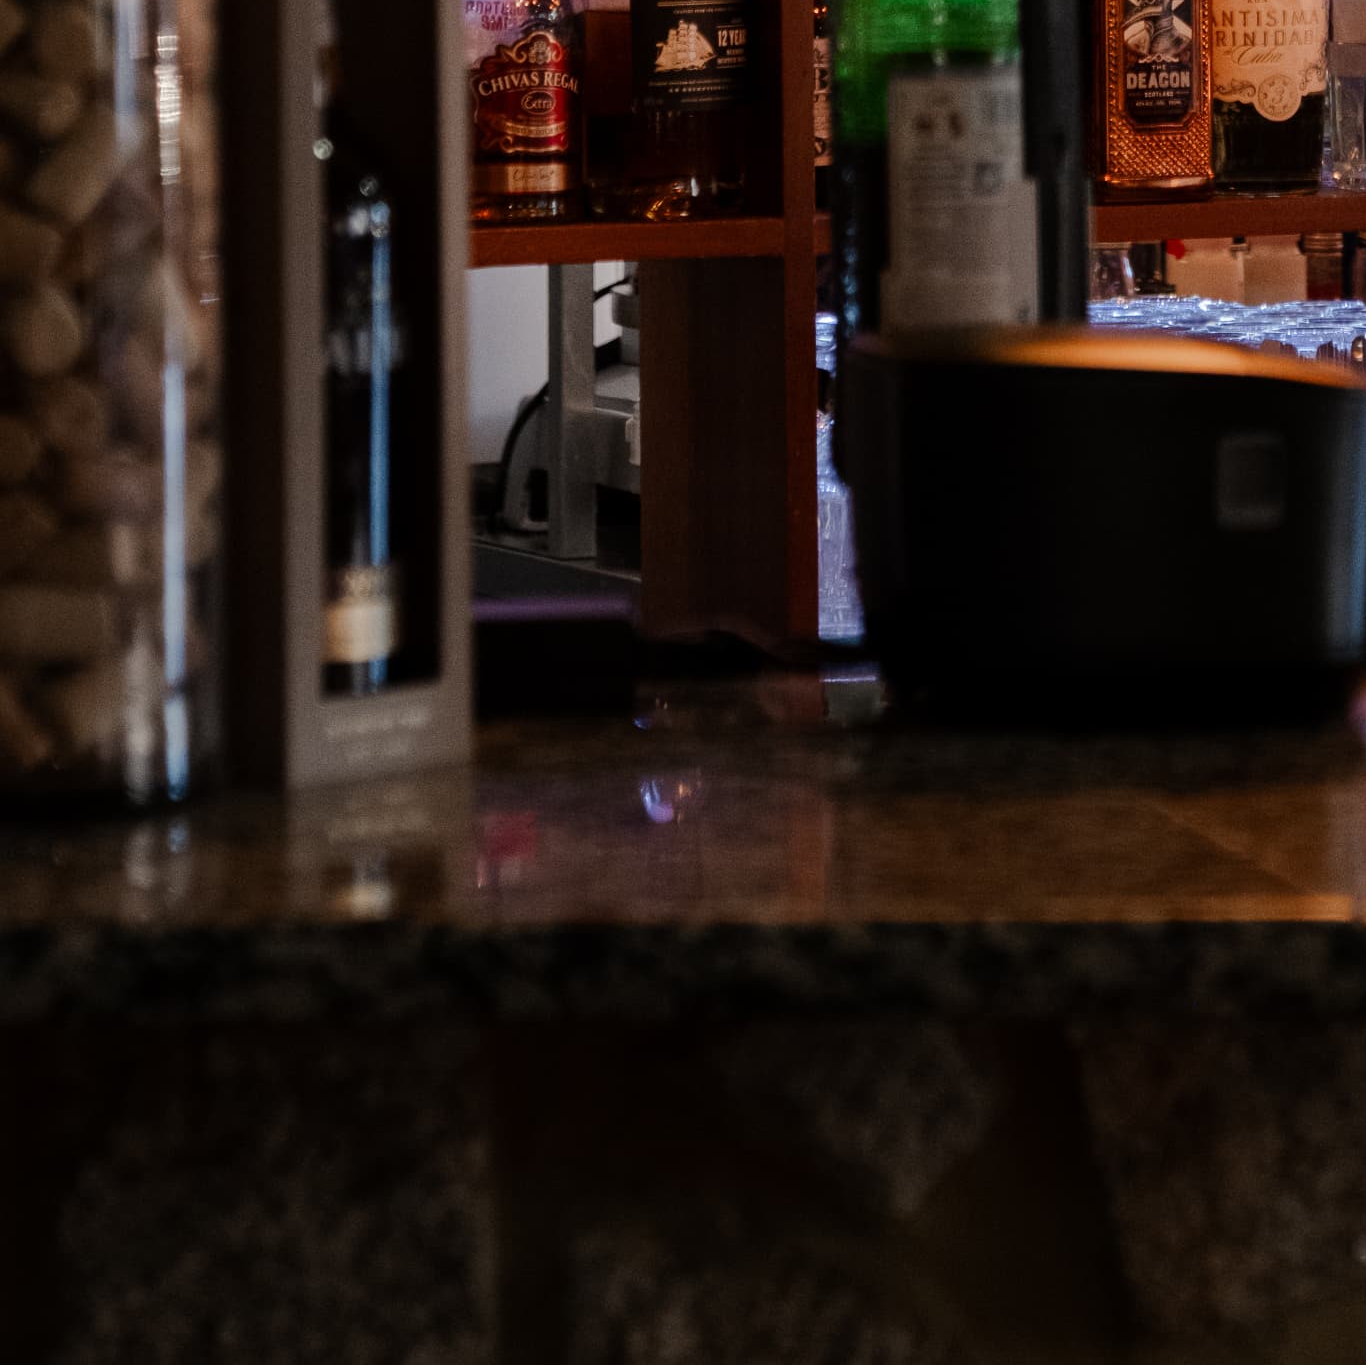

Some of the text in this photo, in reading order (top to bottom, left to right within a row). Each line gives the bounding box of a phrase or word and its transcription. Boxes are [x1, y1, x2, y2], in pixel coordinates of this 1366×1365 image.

[718, 29, 728, 47] 12
[478, 72, 539, 96] CHIVAS
[1126, 70, 1191, 89] DEACON
[524, 95, 555, 110] Extra
